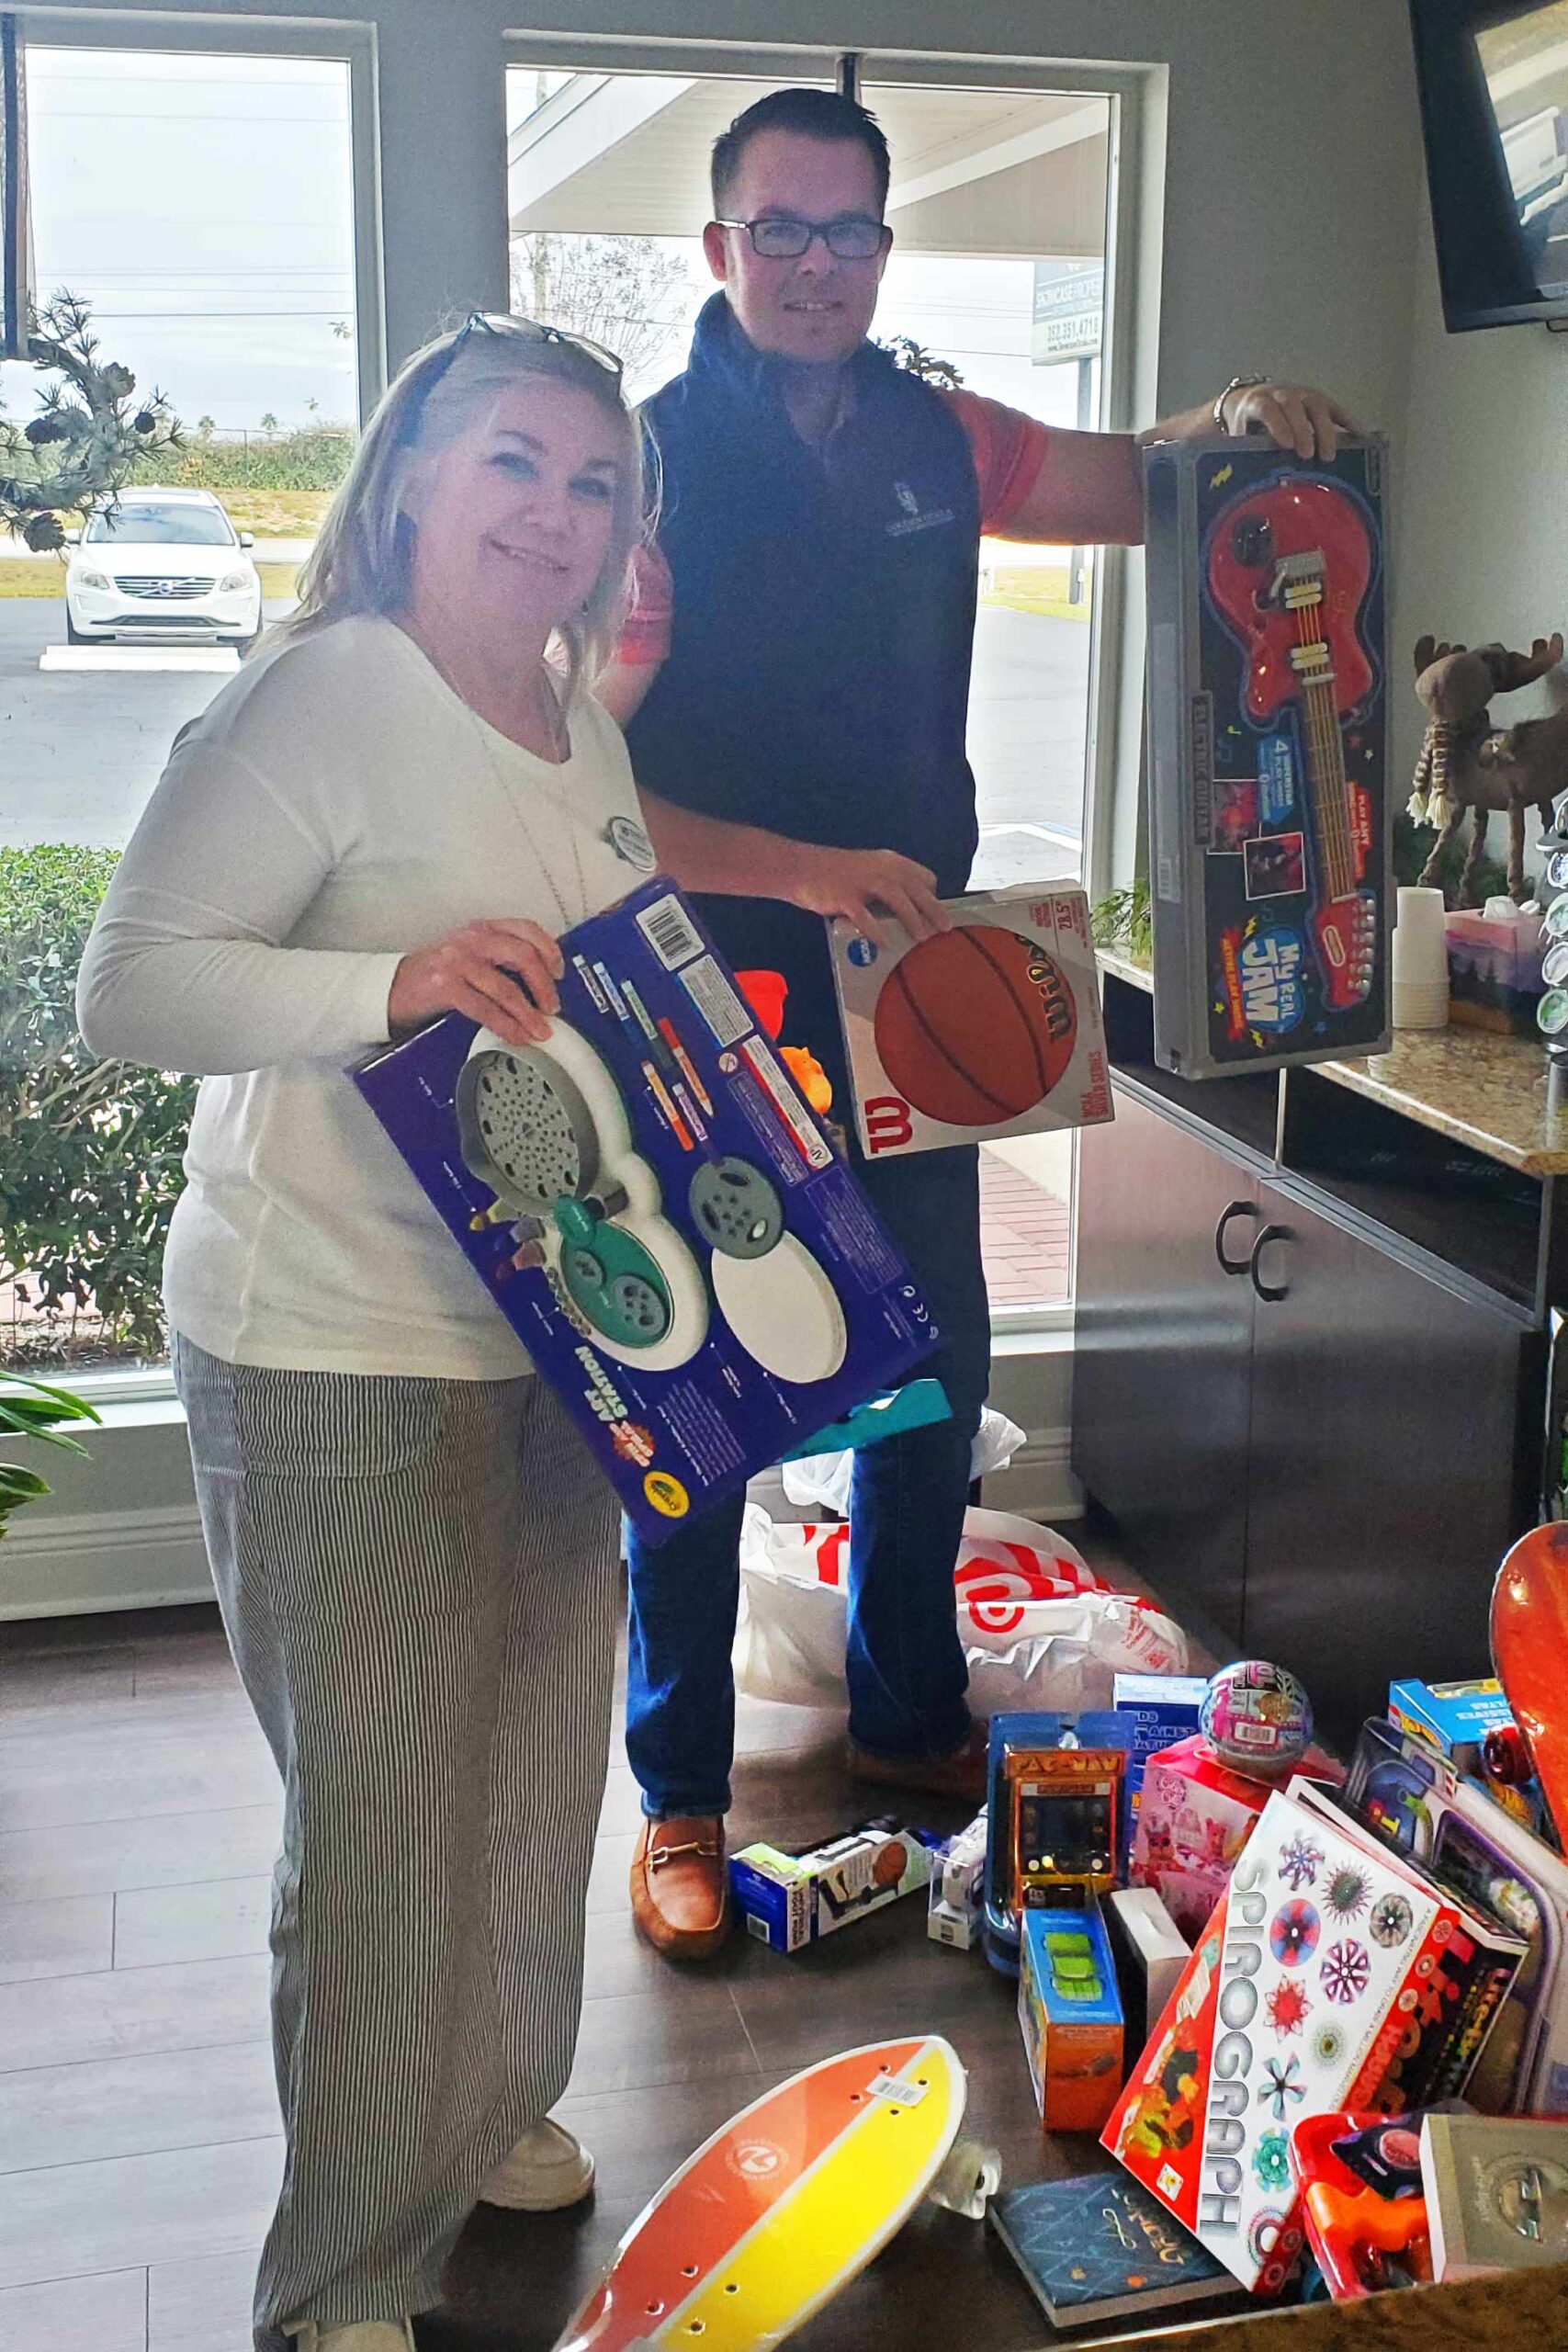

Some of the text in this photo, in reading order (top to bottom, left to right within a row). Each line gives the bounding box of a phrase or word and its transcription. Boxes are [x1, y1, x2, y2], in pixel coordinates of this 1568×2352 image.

[1274, 740, 1289, 753] 4
[1359, 820, 1369, 845] ANY
[1241, 938, 1278, 1022] JAM
[1279, 983, 1297, 1020] REAL
[575, 1345, 628, 1418] STATION
[583, 1387, 615, 1421] ART
[649, 1479, 678, 1511] Crayola
[1200, 1859, 1267, 2235] SPIROGRAPH
